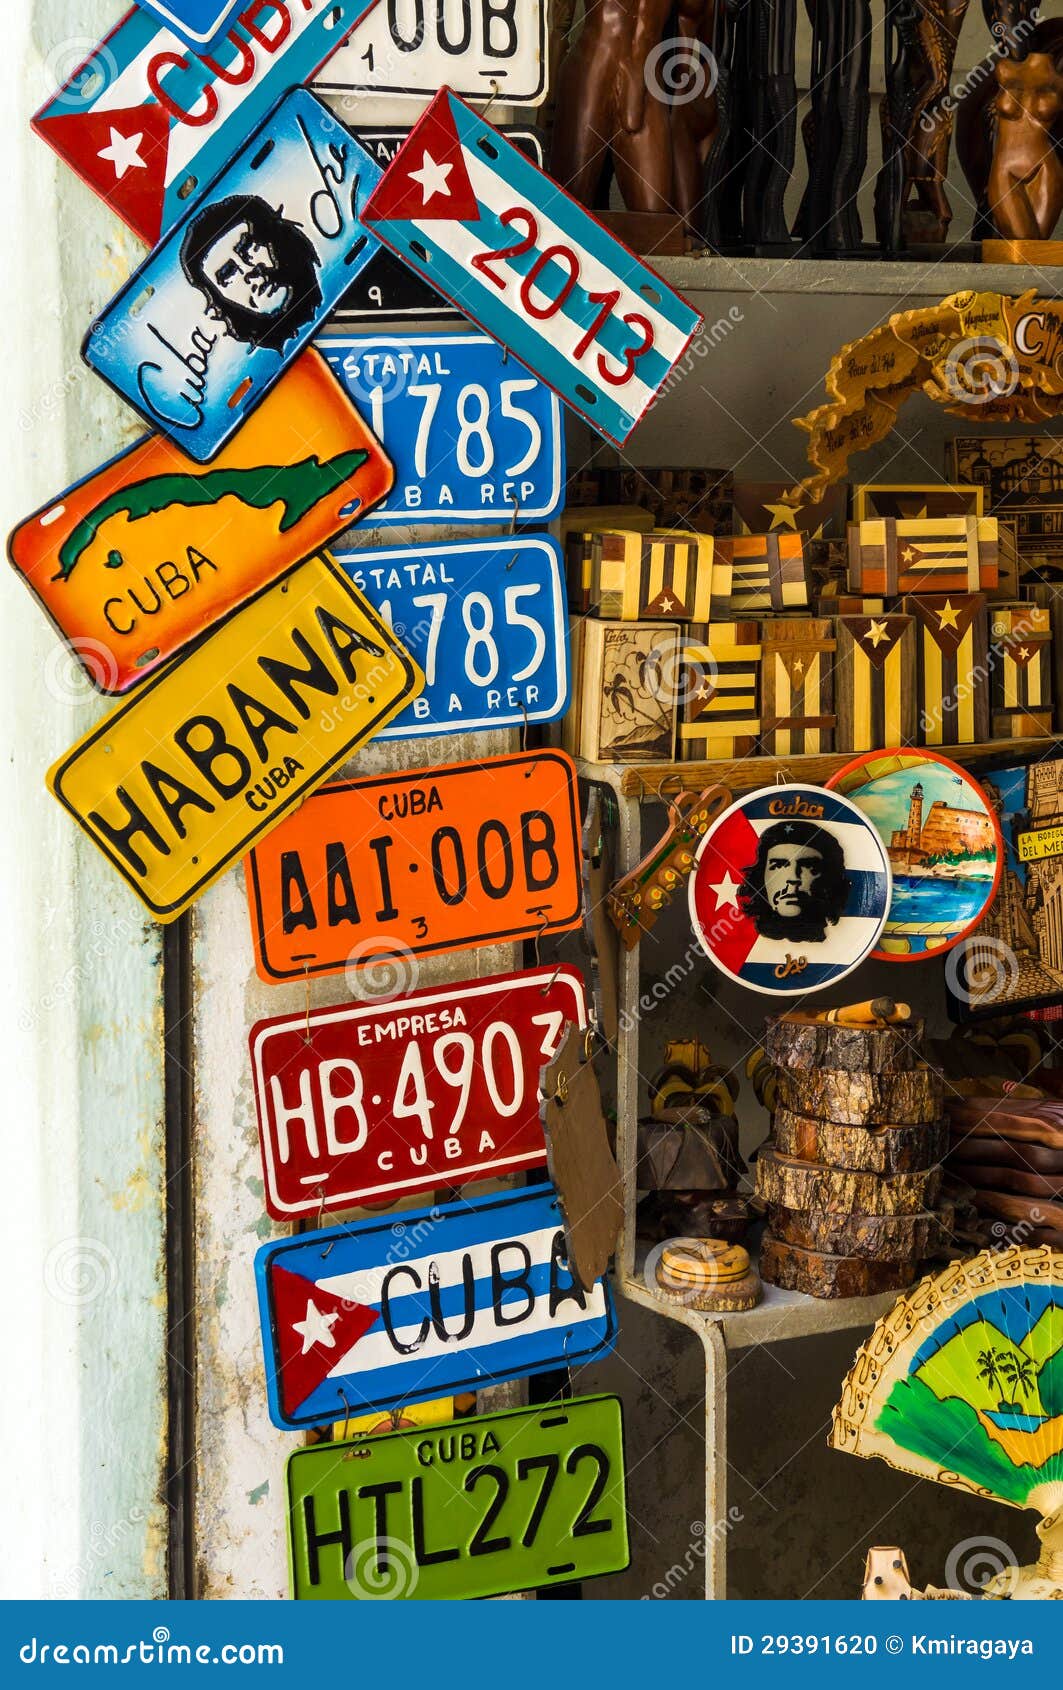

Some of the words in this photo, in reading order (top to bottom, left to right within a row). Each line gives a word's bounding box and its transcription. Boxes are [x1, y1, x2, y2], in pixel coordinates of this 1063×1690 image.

[147, 0, 312, 127] CUB
[471, 206, 656, 386] 2013
[137, 322, 218, 430] Cuba
[368, 378, 542, 479] 1785
[481, 481, 535, 504] REP
[103, 545, 218, 636] CUBA
[353, 562, 455, 592] STATAL
[88, 605, 385, 878] HABANA
[245, 756, 306, 812] CUBA
[378, 786, 444, 821] CUBA
[410, 916, 429, 940] 3
[358, 1006, 467, 1046] EMPRESA
[376, 1130, 496, 1171] CUBA
[381, 1230, 587, 1355] CUBA
[416, 1430, 501, 1467] CUBA
[302, 1443, 613, 1586] HTL272
